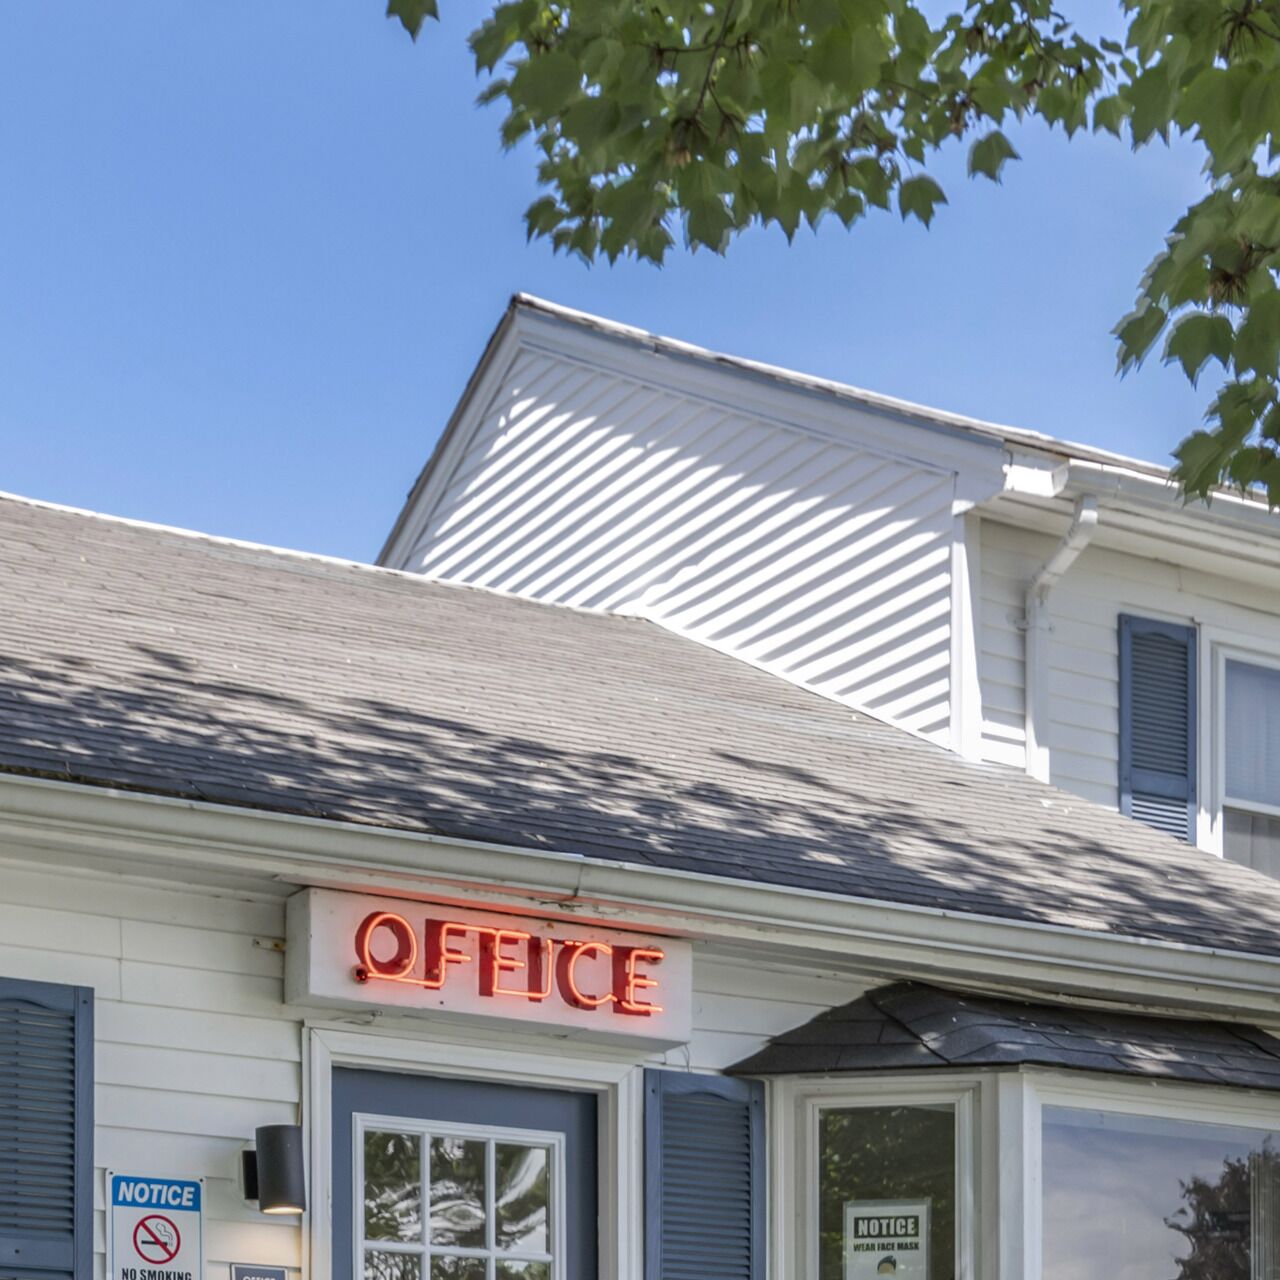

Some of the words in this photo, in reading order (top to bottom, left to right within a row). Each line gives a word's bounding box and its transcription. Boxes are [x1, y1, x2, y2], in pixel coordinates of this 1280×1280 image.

[355, 911, 664, 1016] OFFICE
[118, 1181, 195, 1206] NOTICE
[858, 1218, 915, 1236] NOTICE
[853, 1242, 876, 1252] WEAR
[877, 1242, 895, 1252] FACE
[897, 1241, 919, 1251] MASK
[121, 1268, 137, 1280] NO
